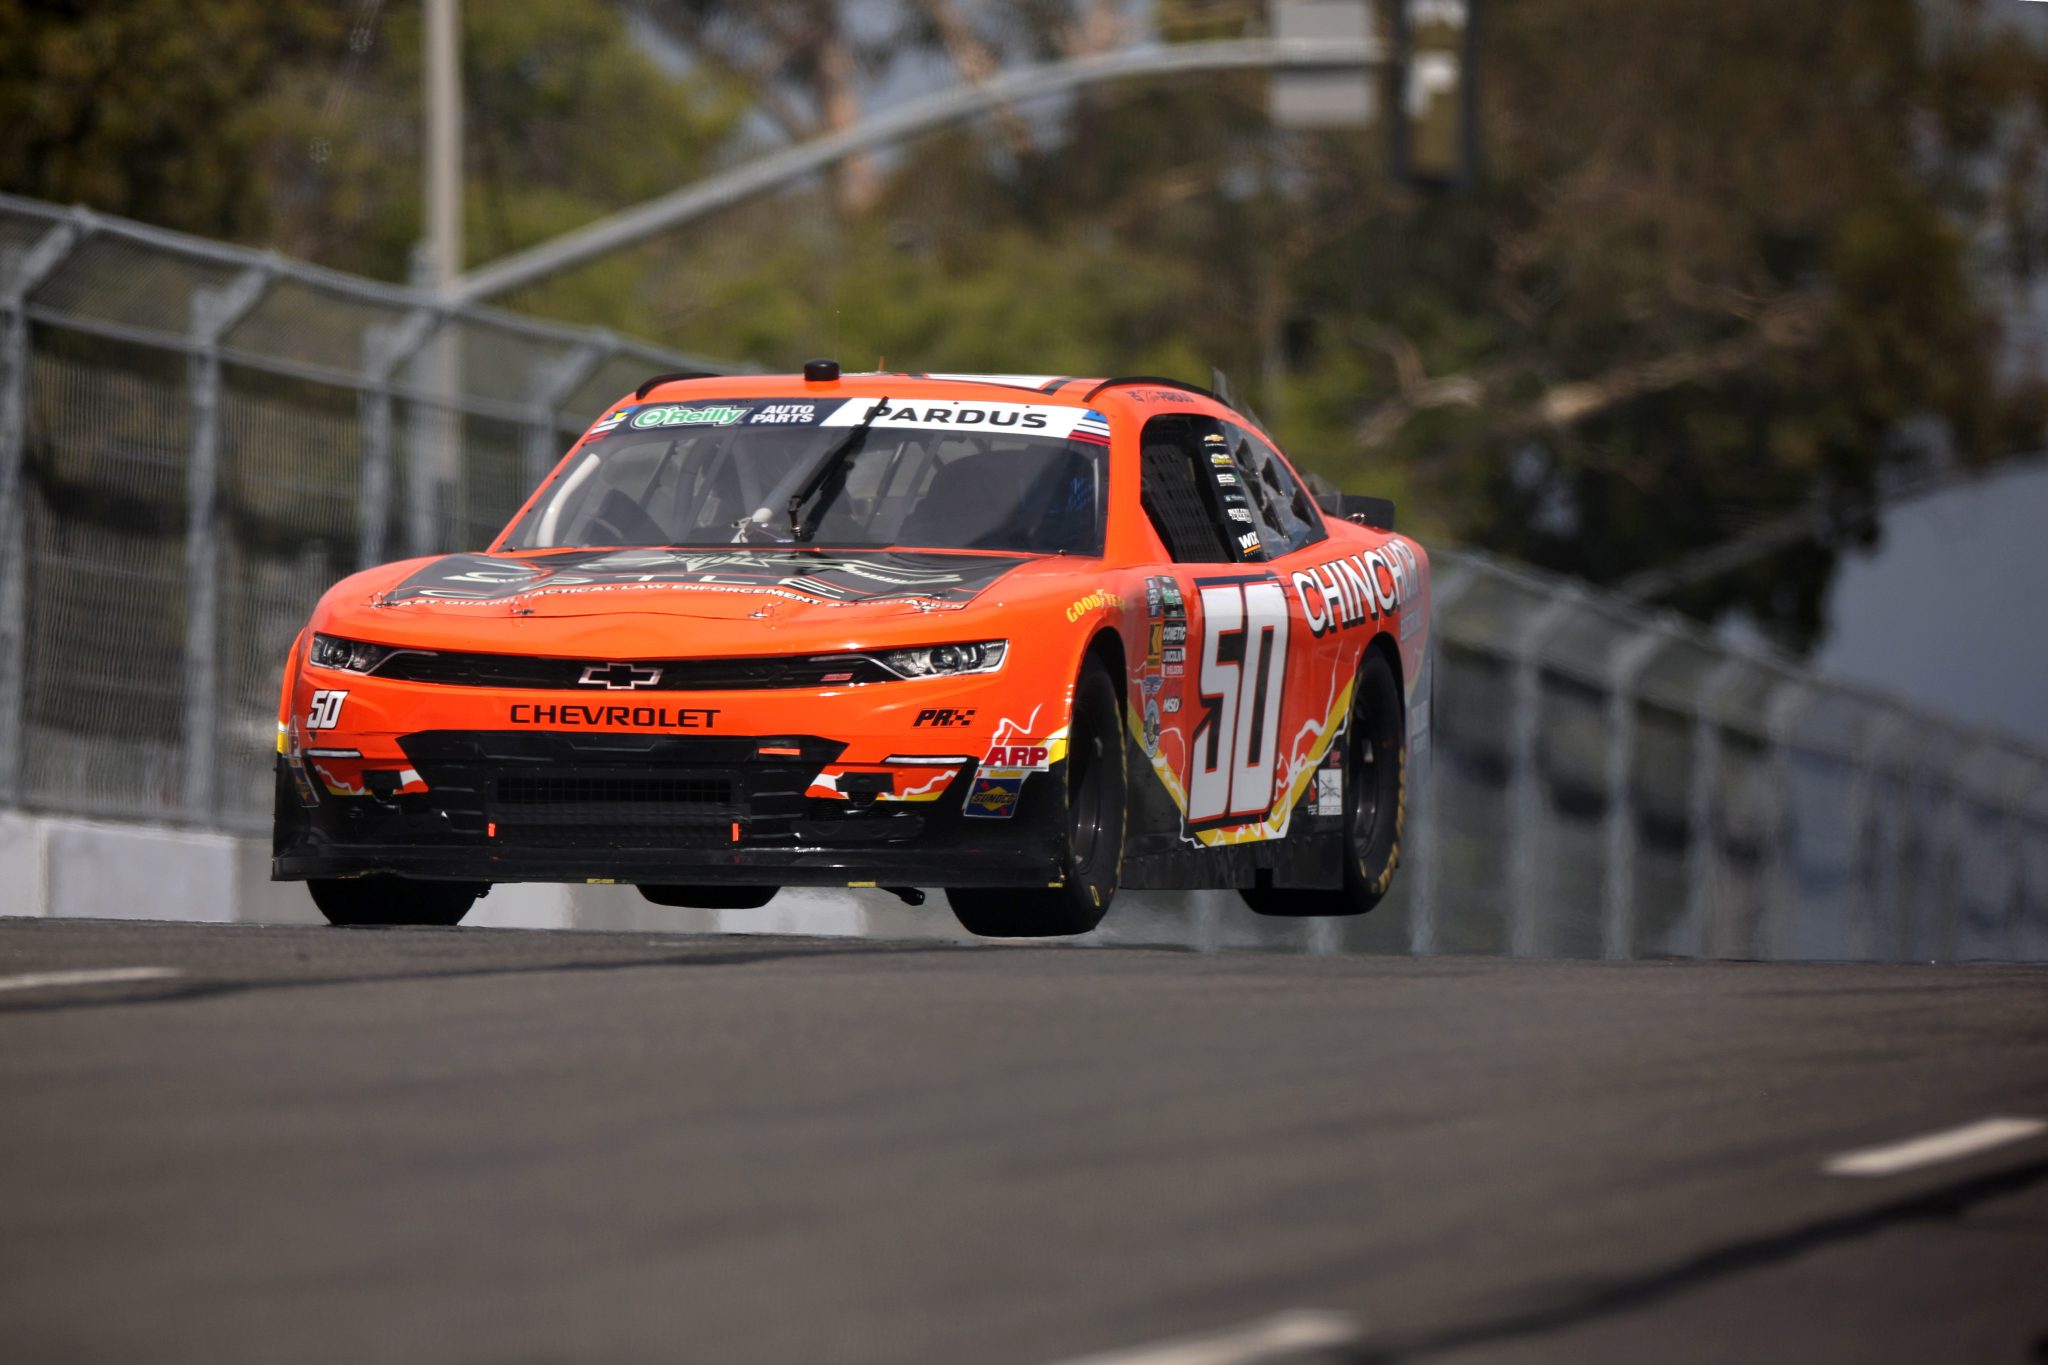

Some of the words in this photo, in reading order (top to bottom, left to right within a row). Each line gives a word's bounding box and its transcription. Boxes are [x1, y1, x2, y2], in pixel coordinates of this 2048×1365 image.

[634, 406, 748, 426] O'Reilly
[750, 413, 815, 423] PARTS
[762, 405, 815, 414] AUTO
[863, 406, 1048, 428] PARDUS
[1239, 531, 1259, 549] WIX
[620, 583, 667, 591] LAW
[671, 584, 822, 605] ENFORCEMENT
[306, 689, 349, 729] 50
[1187, 581, 1290, 822] 50
[511, 704, 721, 728] CHEVROLET
[983, 747, 1048, 766] ARP
